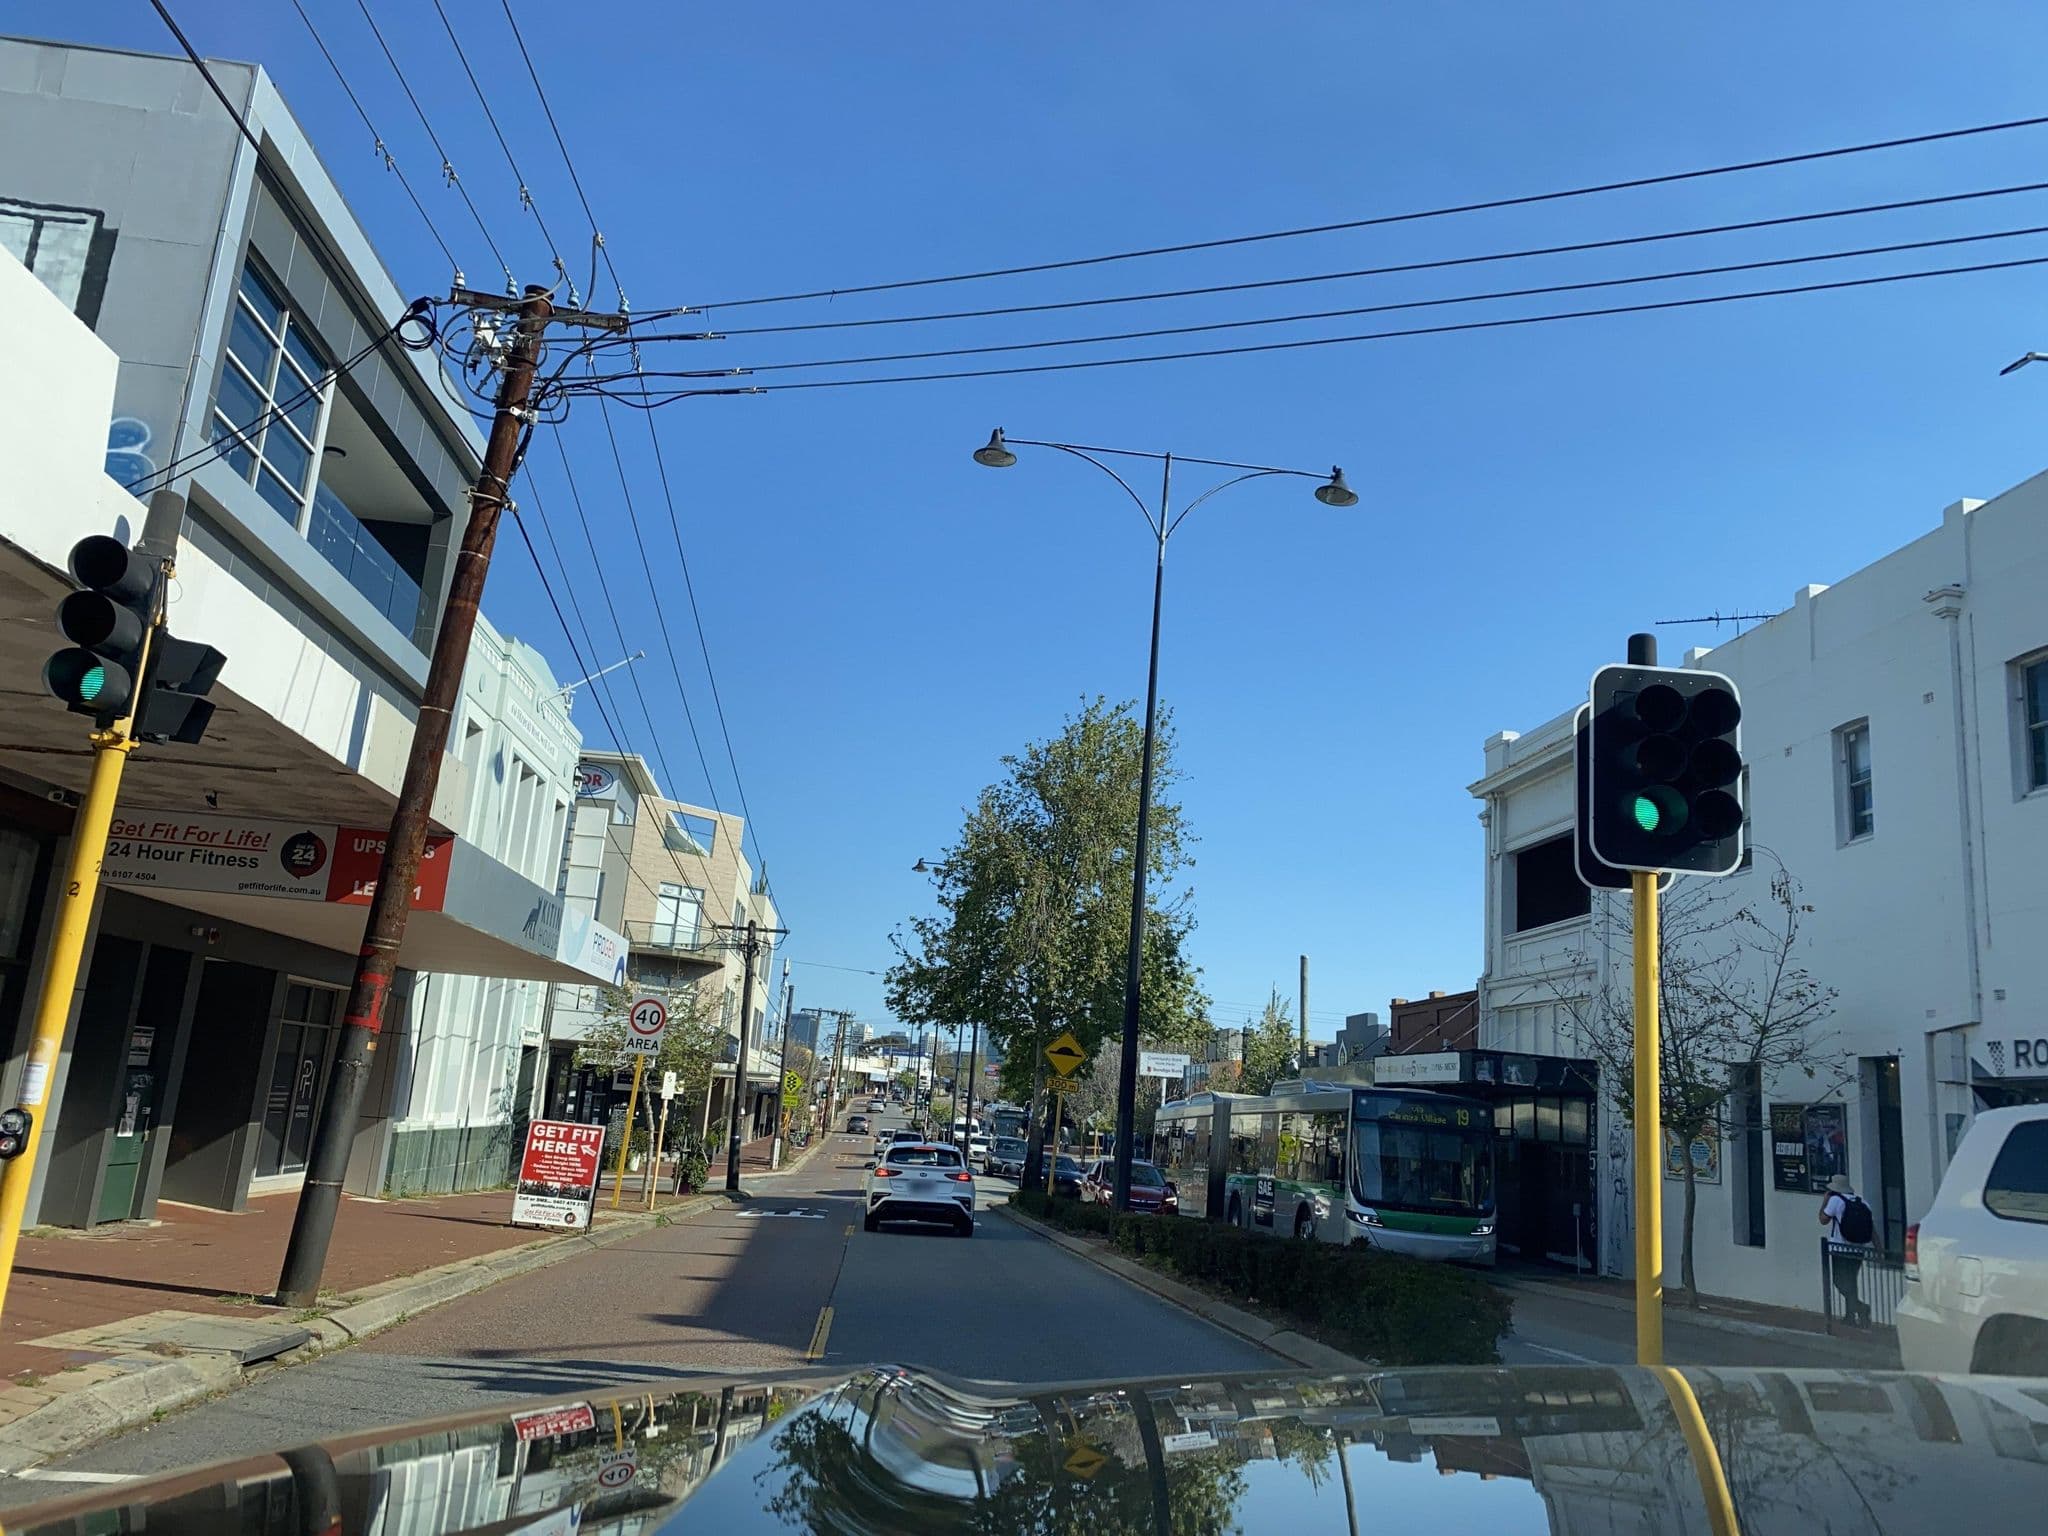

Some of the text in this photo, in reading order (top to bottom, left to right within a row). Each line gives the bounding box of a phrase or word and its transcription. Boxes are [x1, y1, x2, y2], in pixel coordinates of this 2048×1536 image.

[110, 819, 271, 848] Get Fit For Life!
[108, 842, 260, 869] 24 Hour Fitness
[291, 848, 316, 862] 24
[353, 838, 435, 859] UPSS
[112, 869, 133, 880] 6107
[135, 871, 156, 881] 4504
[68, 882, 80, 897] 2
[238, 881, 321, 895] getfitforlife.com.au
[413, 886, 422, 900] 1
[635, 1009, 661, 1026] 40
[626, 1038, 659, 1051] AREA
[1049, 1080, 1067, 1090] 300
[1455, 1108, 1470, 1126] 19
[533, 1124, 599, 1143] GET FIT
[531, 1139, 579, 1155] HERE
